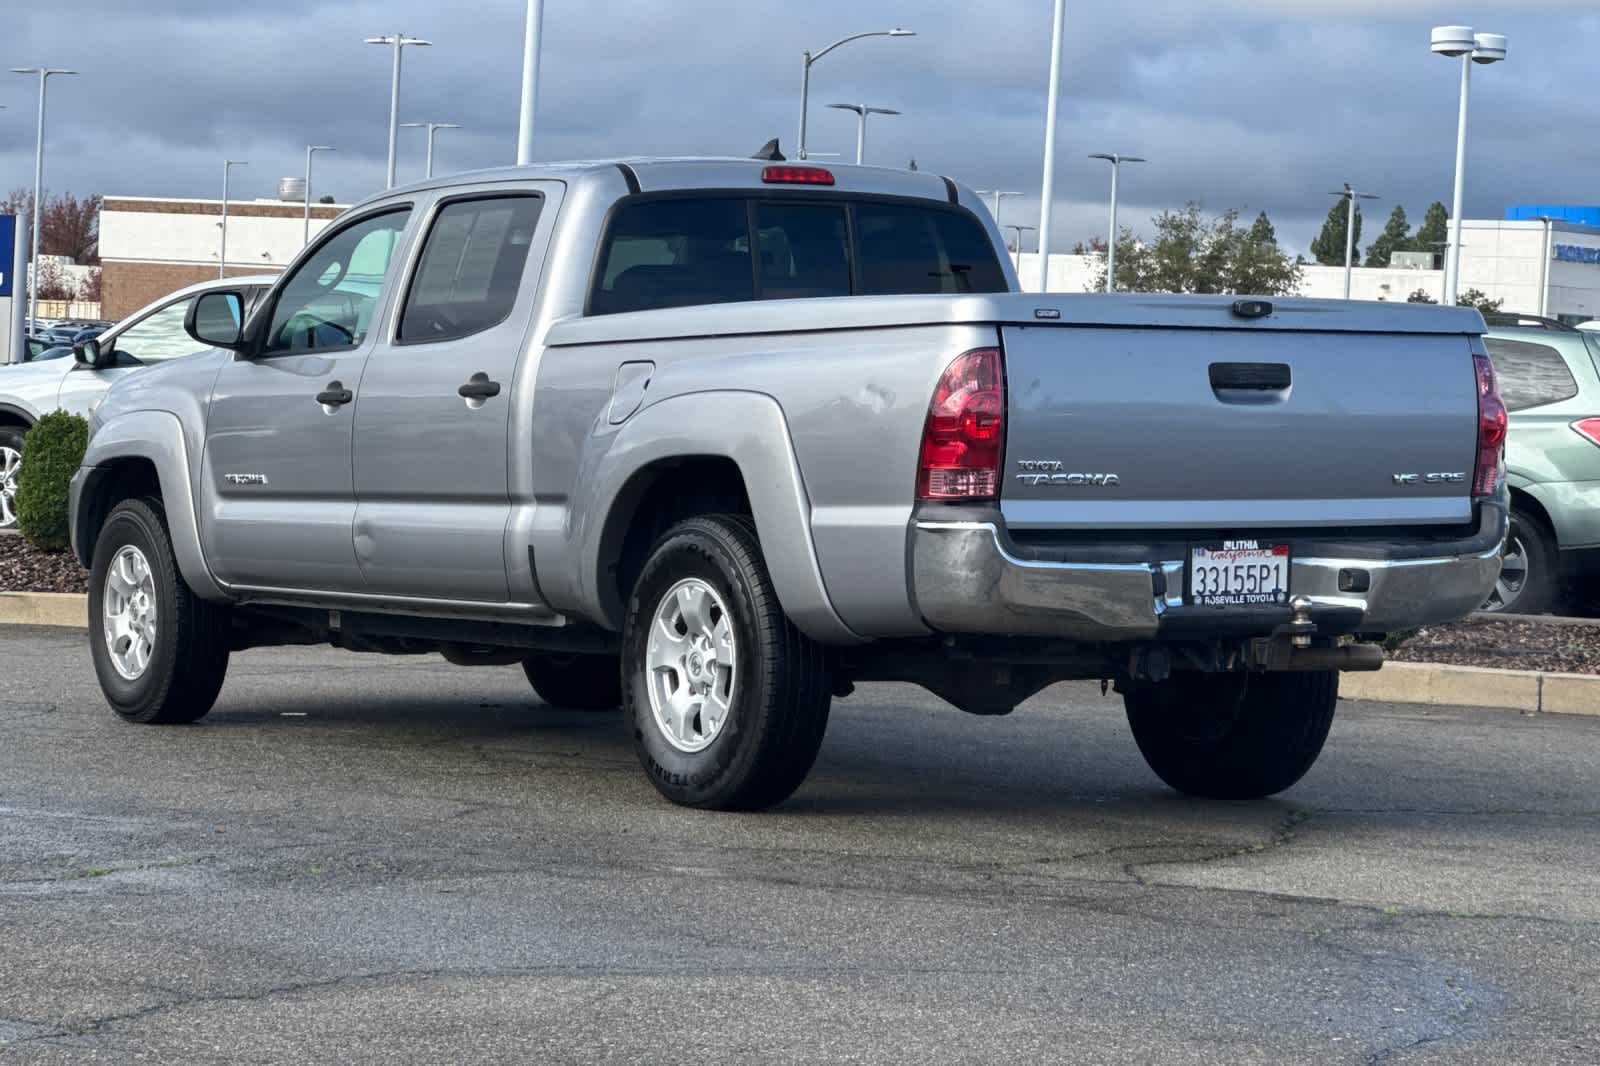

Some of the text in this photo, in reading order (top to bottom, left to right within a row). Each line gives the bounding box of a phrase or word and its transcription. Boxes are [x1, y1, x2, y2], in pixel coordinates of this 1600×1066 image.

[1017, 460, 1063, 471] TOYOTA
[1016, 473, 1121, 486] TACOMA
[1231, 540, 1259, 550] LITHIA
[1196, 563, 1282, 595] 33155P1
[1205, 592, 1275, 605] ROSEVILLE TOYOTA
